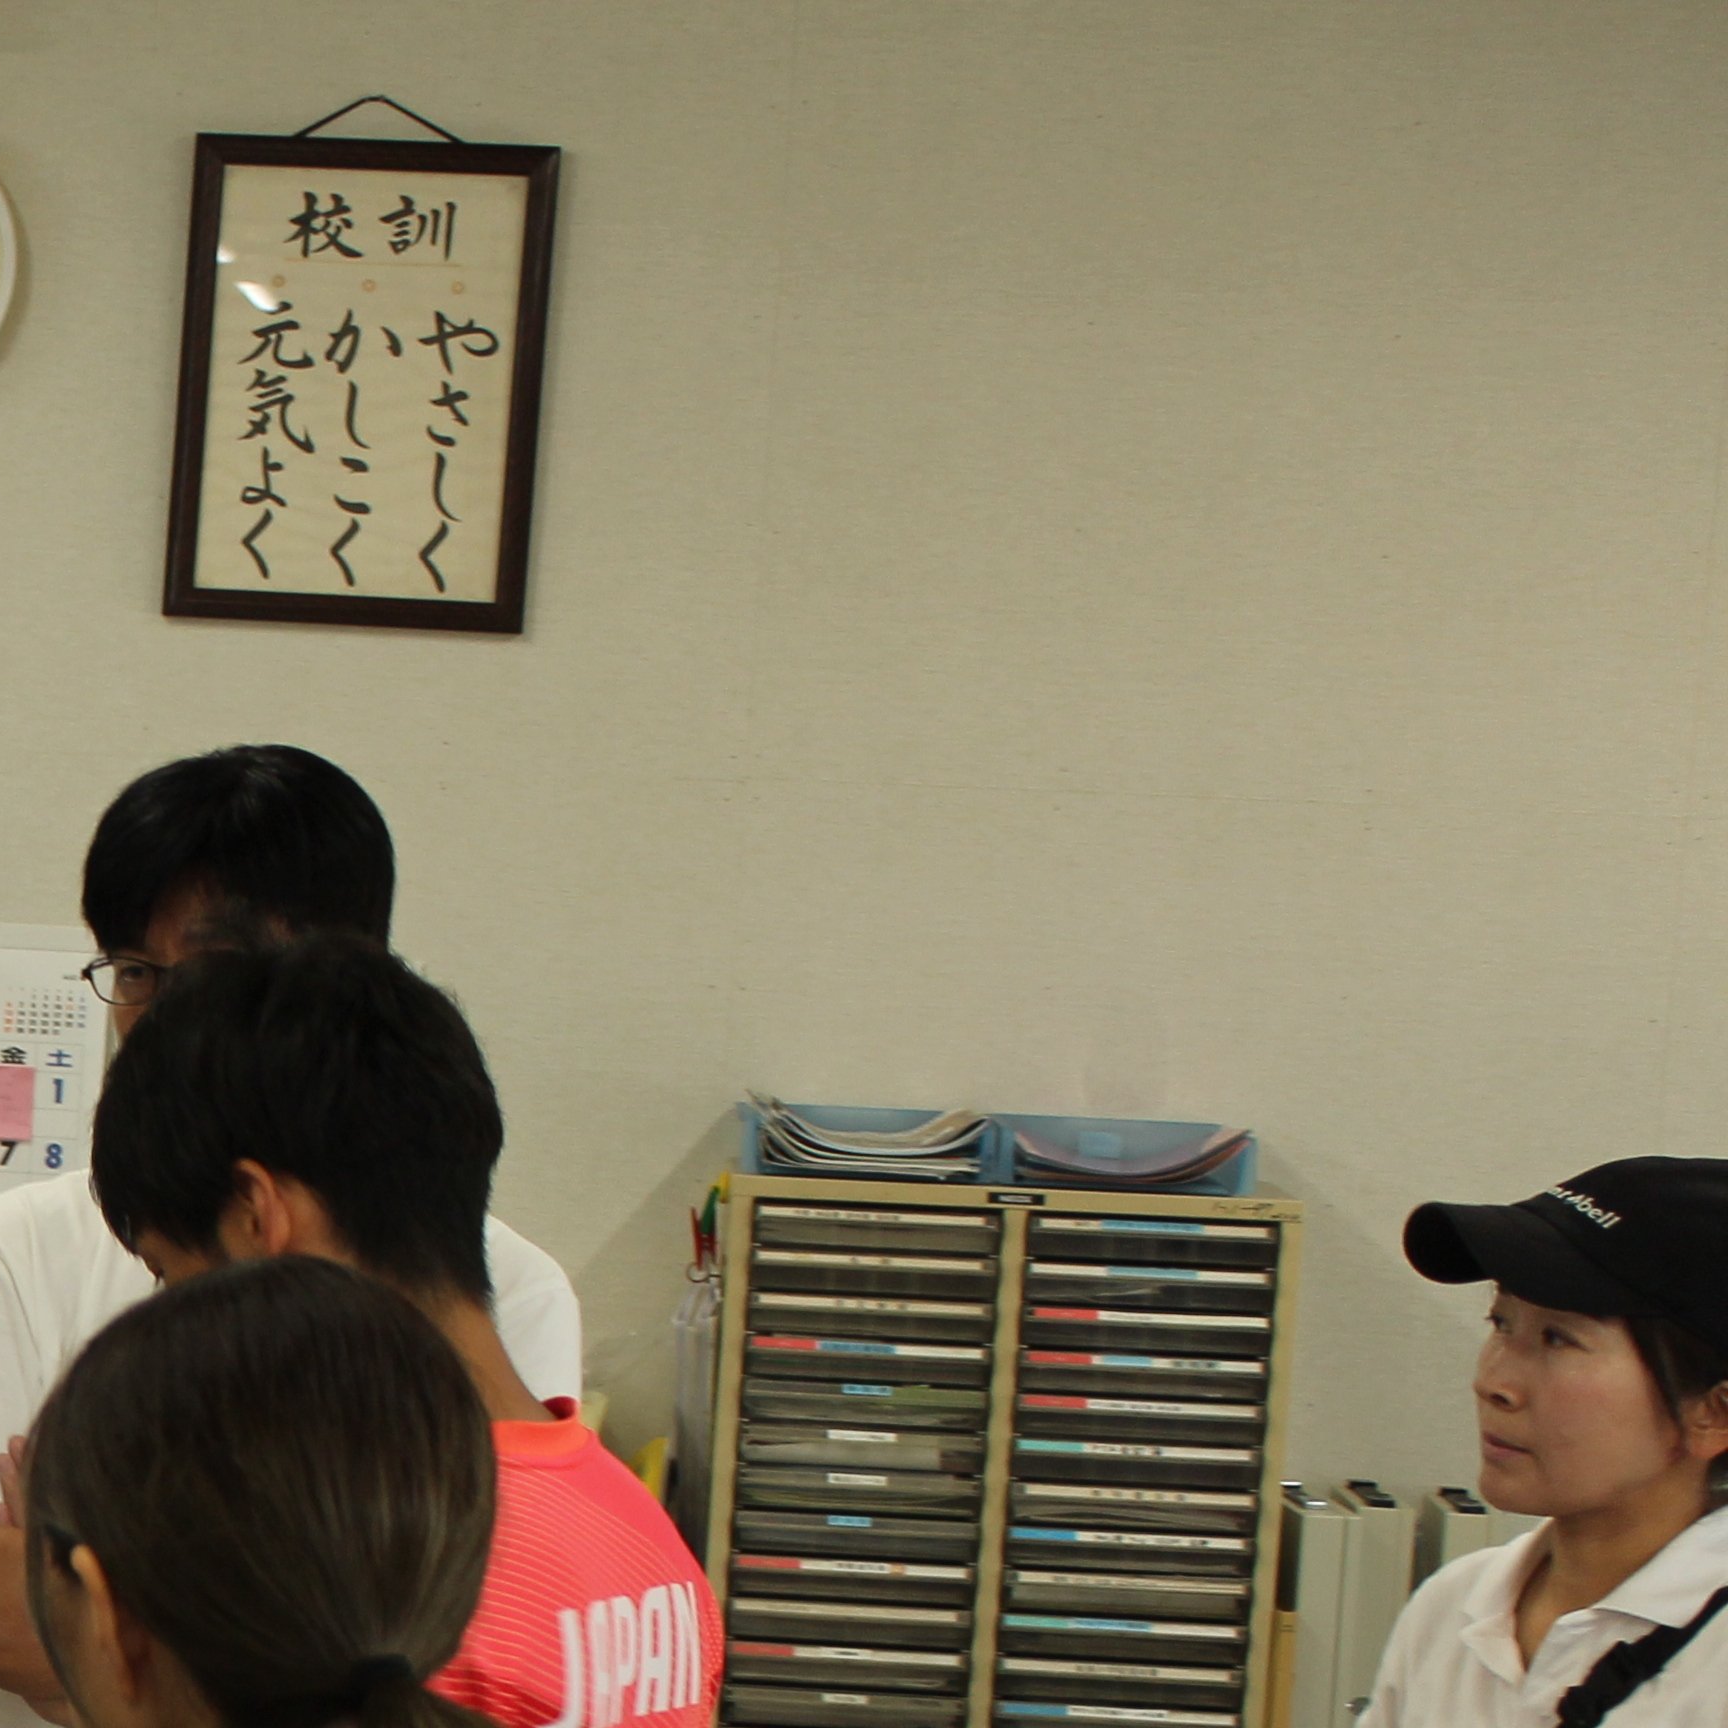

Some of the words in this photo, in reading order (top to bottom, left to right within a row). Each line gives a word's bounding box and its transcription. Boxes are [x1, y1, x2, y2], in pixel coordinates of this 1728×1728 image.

[283, 190, 457, 260] 校訓
[237, 300, 315, 580] 元気よく
[324, 308, 403, 587] かしこく
[417, 309, 500, 593] やさしく
[0, 1046, 28, 1065] 金
[45, 1050, 74, 1068] 土
[52, 1078, 64, 1104] 1
[44, 1142, 63, 1169] 8
